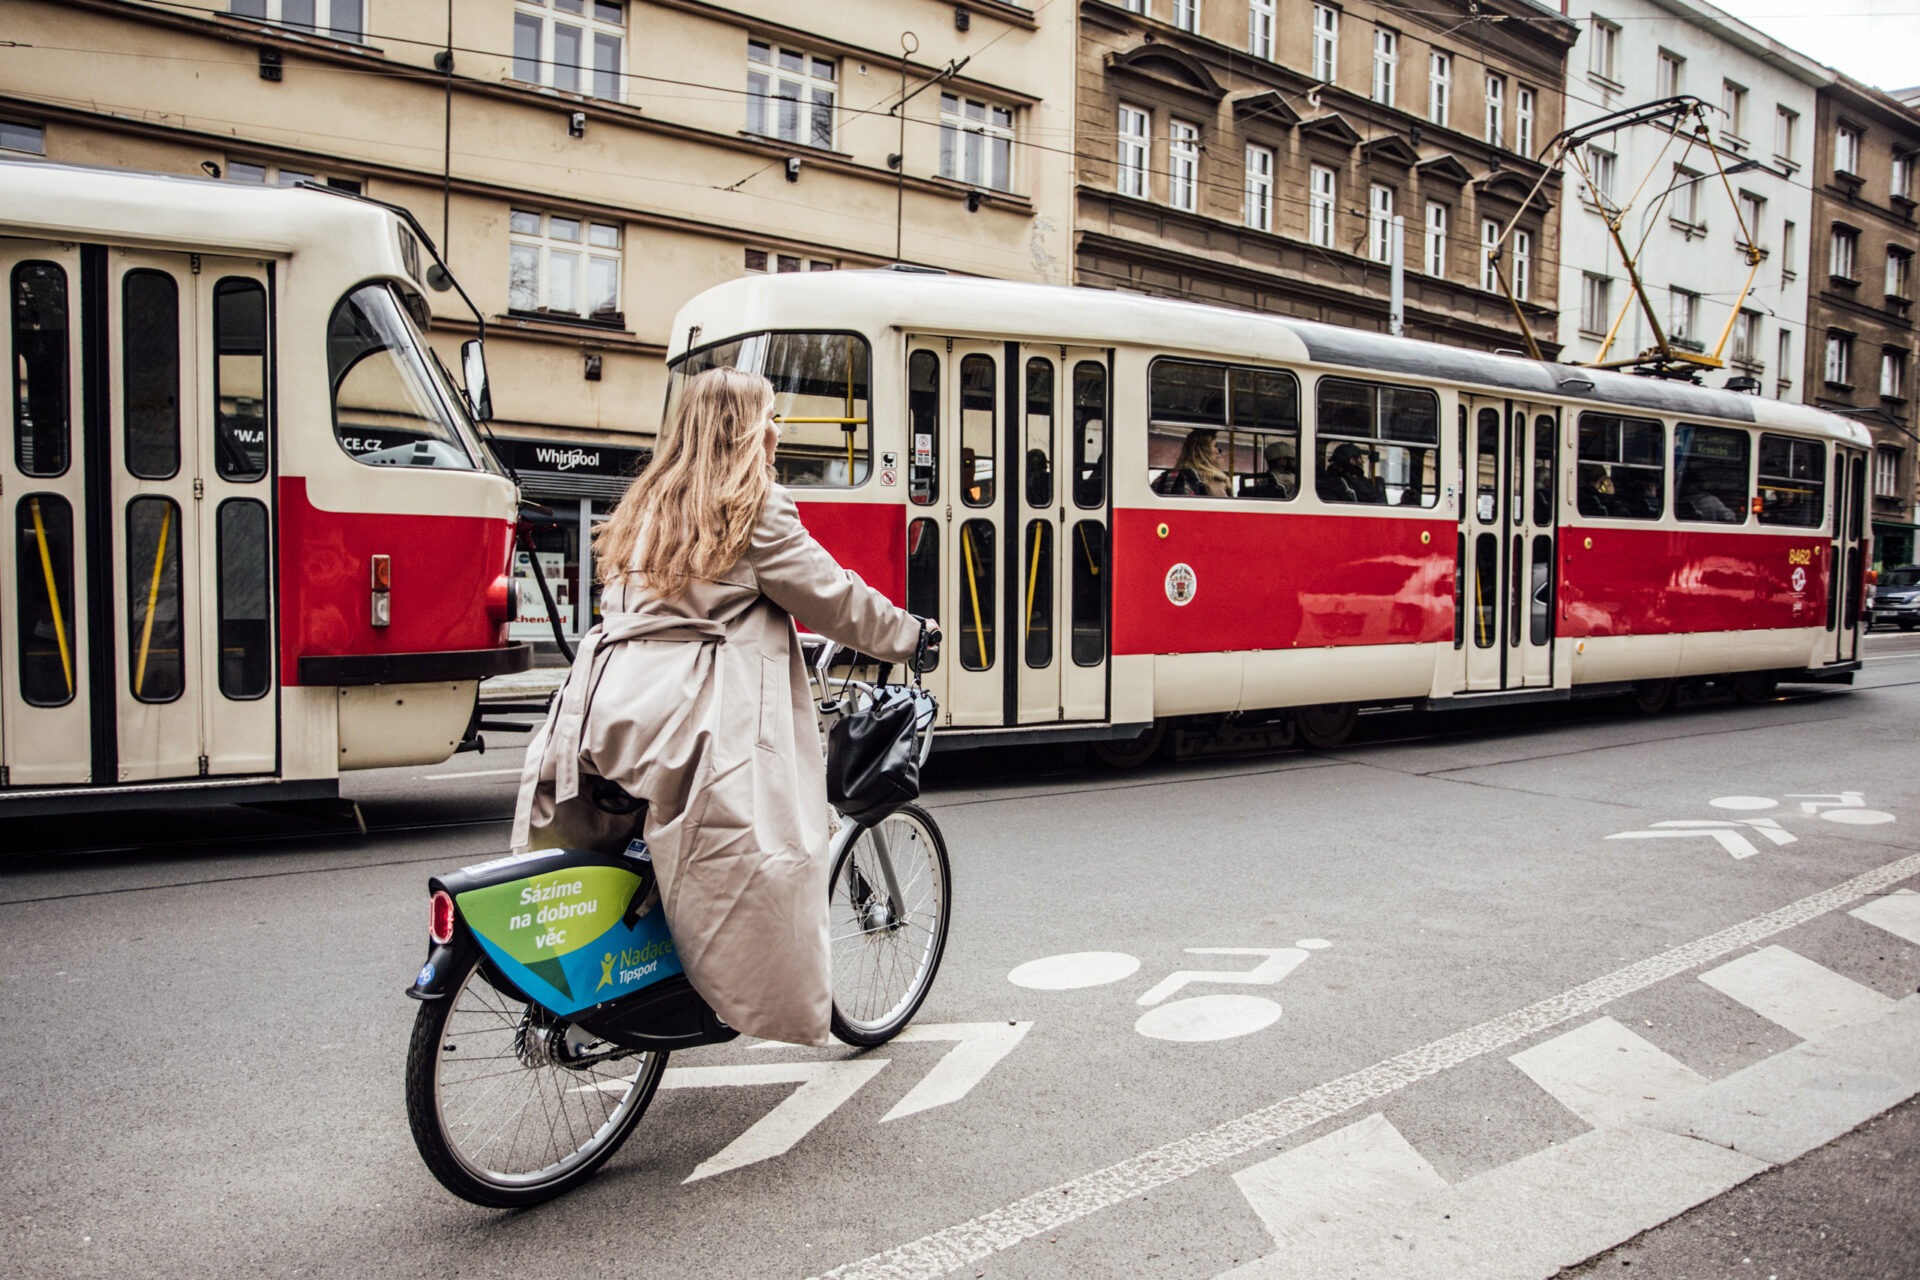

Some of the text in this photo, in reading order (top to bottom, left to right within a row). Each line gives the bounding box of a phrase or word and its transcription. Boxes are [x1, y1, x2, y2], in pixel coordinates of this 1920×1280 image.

[536, 447, 600, 471] Whirlpool
[1788, 548, 1811, 565] 8462
[520, 881, 582, 905] Sázíme
[510, 900, 597, 930] na dobrou
[536, 926, 566, 949] věc
[620, 940, 673, 969] Nadace
[619, 959, 658, 985] Tipsport
